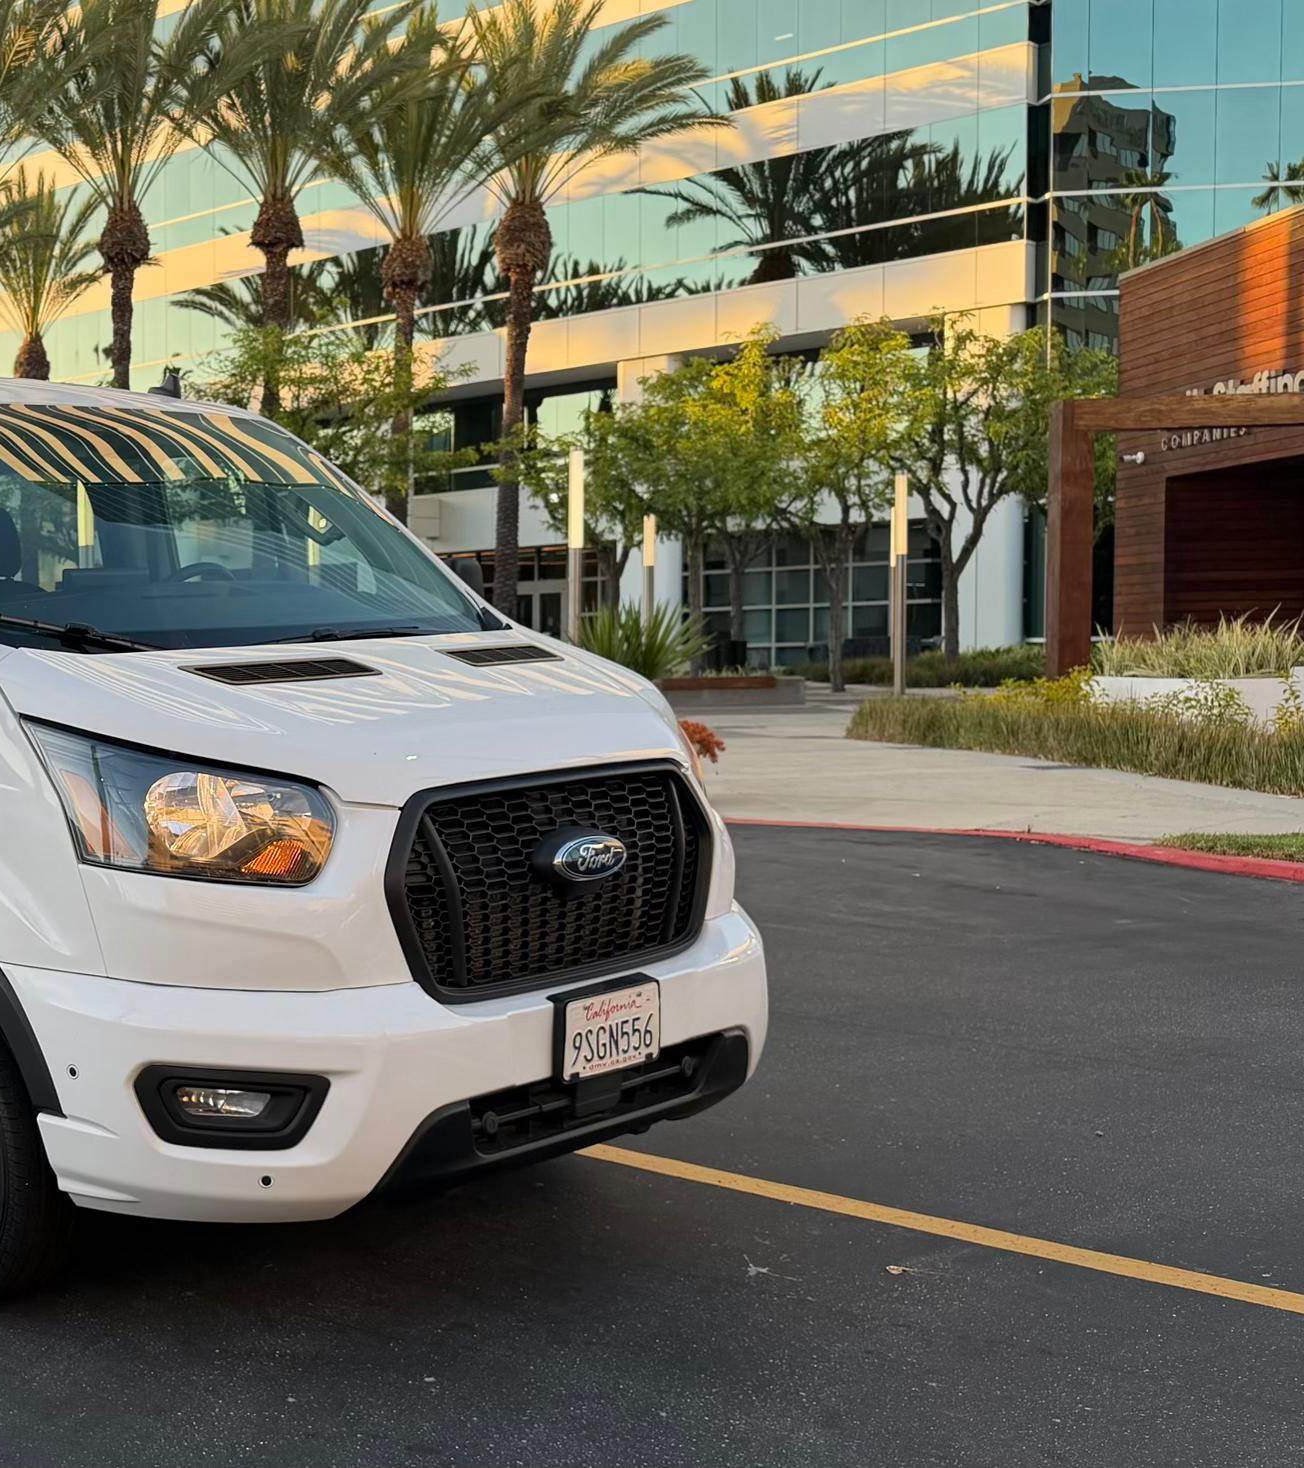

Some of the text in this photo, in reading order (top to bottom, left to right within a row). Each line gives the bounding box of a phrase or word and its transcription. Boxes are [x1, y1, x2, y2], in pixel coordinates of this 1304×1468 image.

[1161, 427, 1247, 451] COMPANIES
[577, 843, 623, 871] Ford
[584, 997, 642, 1021] California
[572, 1013, 653, 1068] 9SGN556
[589, 1055, 637, 1071] dmv.ca.gov
